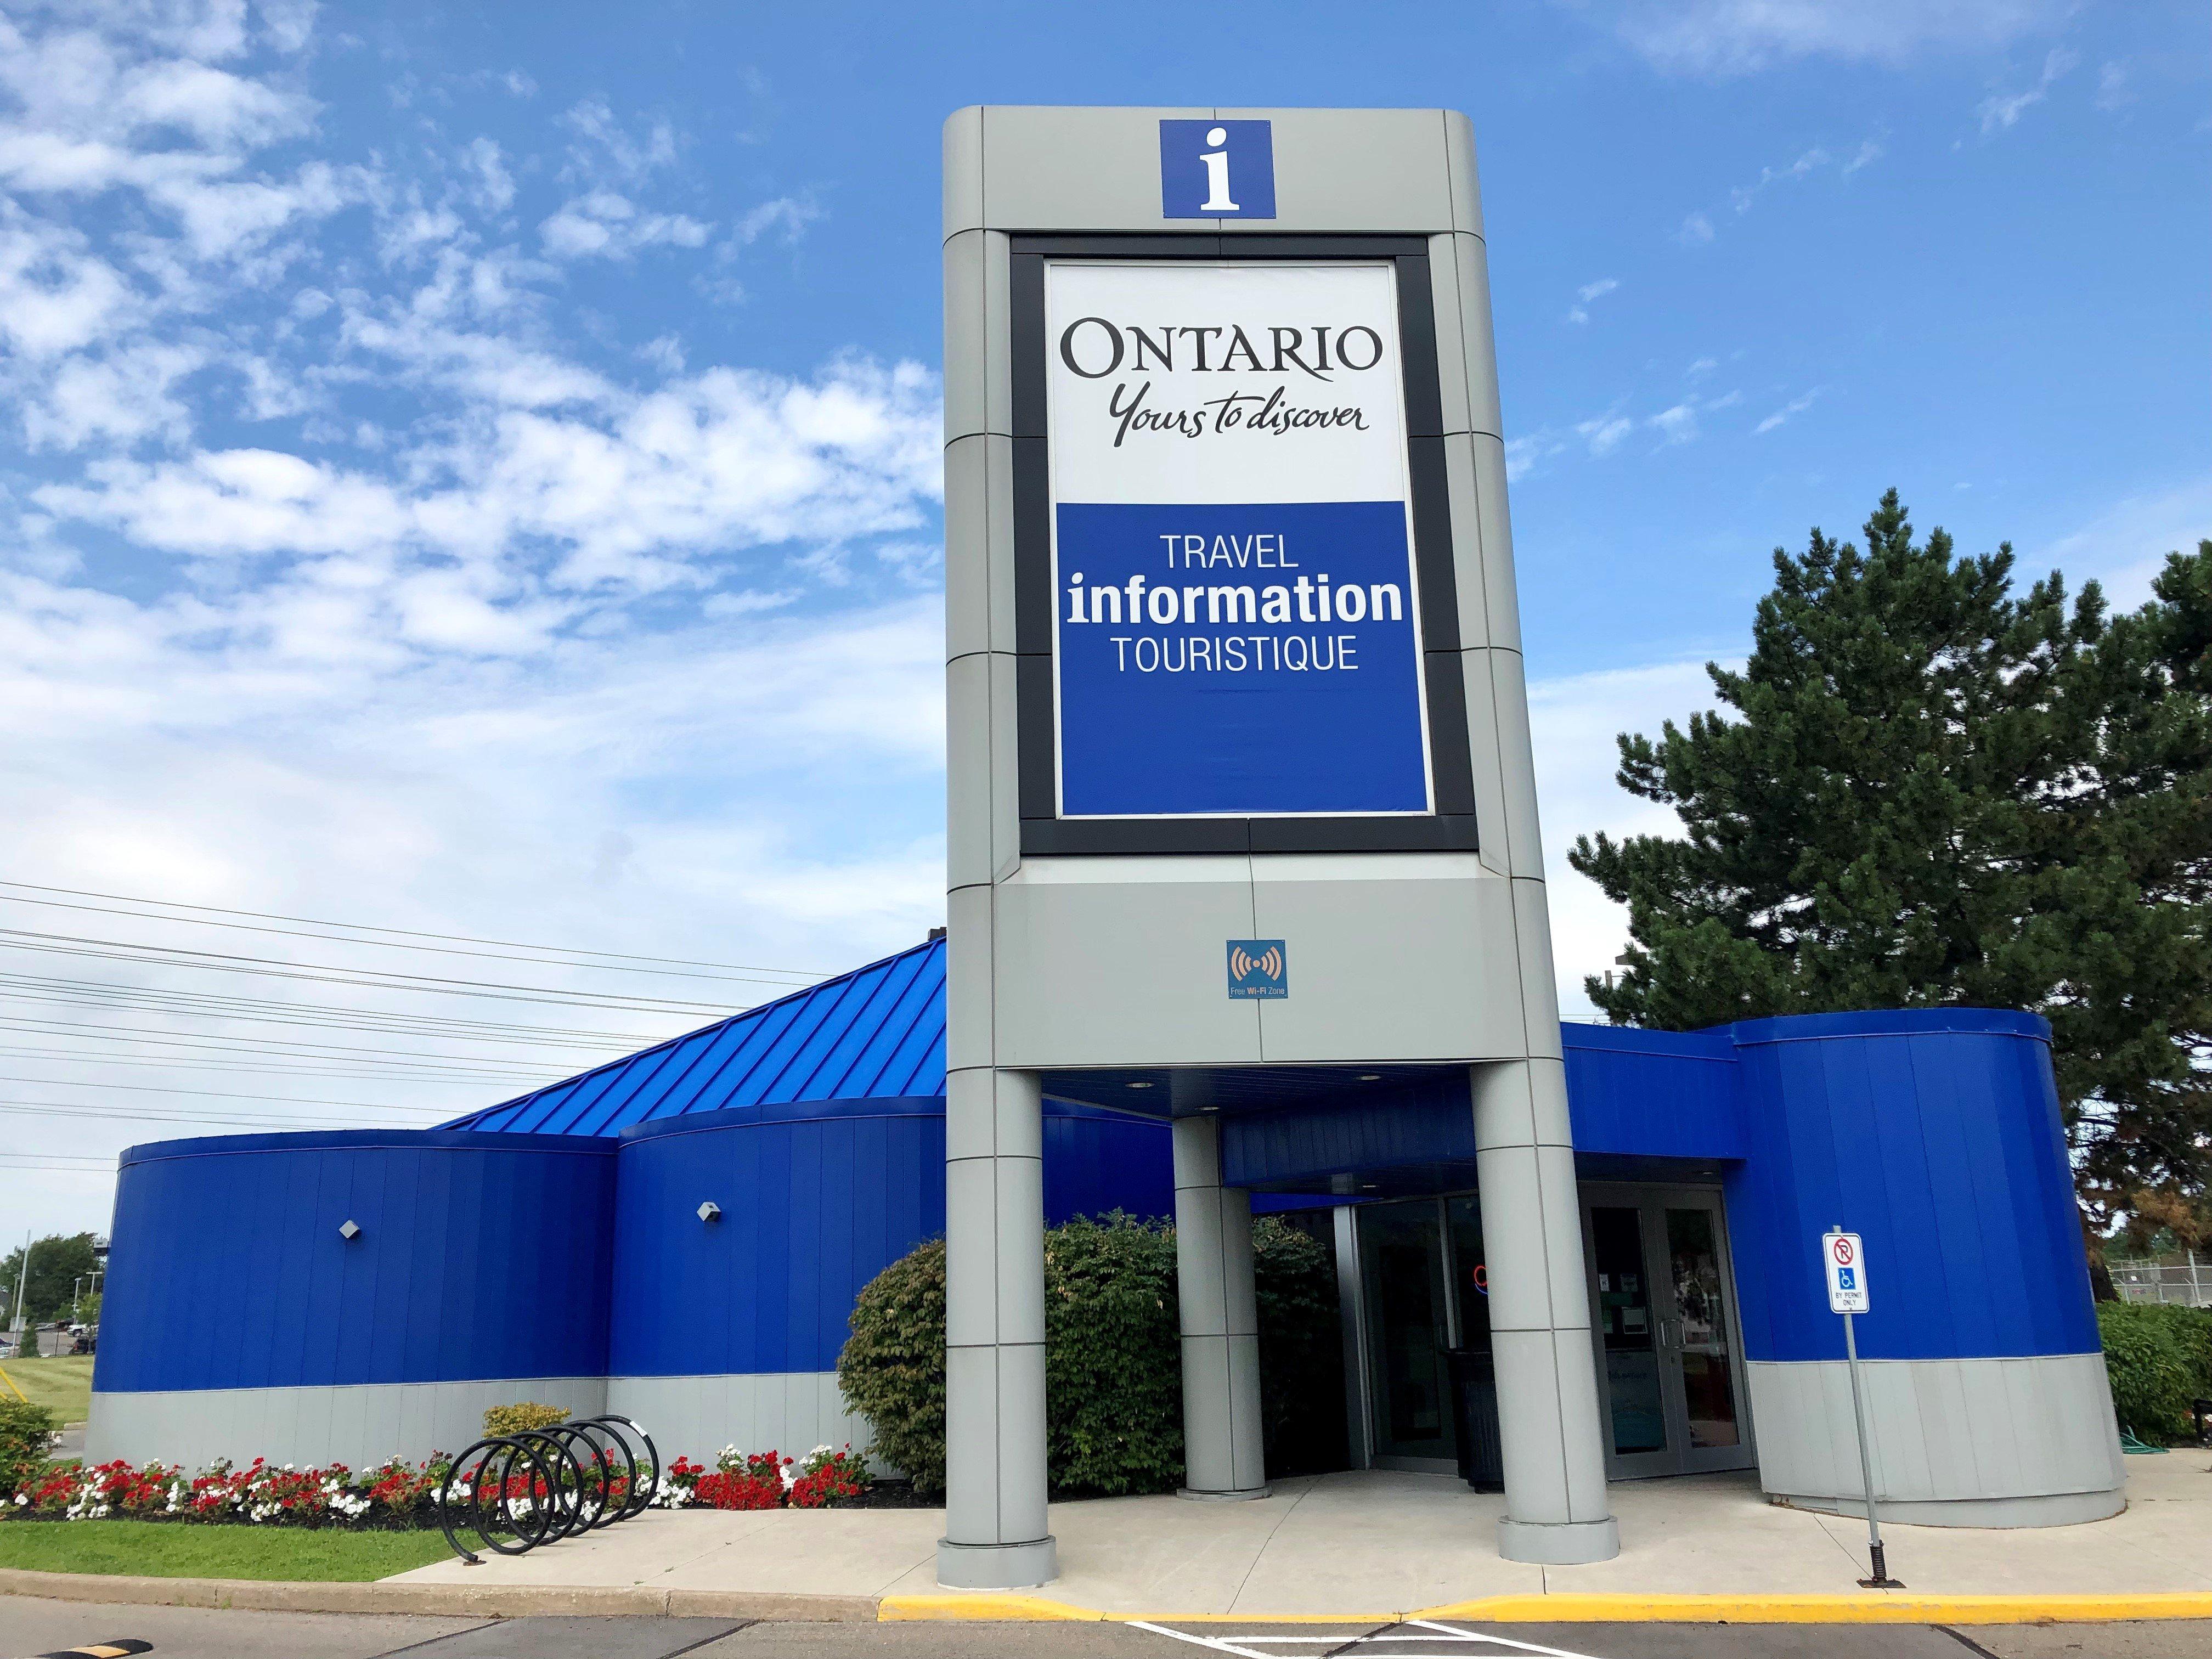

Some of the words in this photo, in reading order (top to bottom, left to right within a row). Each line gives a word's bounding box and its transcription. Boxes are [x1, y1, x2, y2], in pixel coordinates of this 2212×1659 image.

[1199, 127, 1240, 211] i
[1060, 317, 1383, 382] ONTARIO
[1109, 381, 1206, 448] Yours
[1203, 390, 1266, 434] to
[1246, 386, 1370, 436] discover
[1159, 534, 1299, 568] TRAVEL
[1066, 572, 1402, 624] information
[1110, 635, 1358, 672] TOURISTIQUE
[1231, 987, 1246, 995] Free
